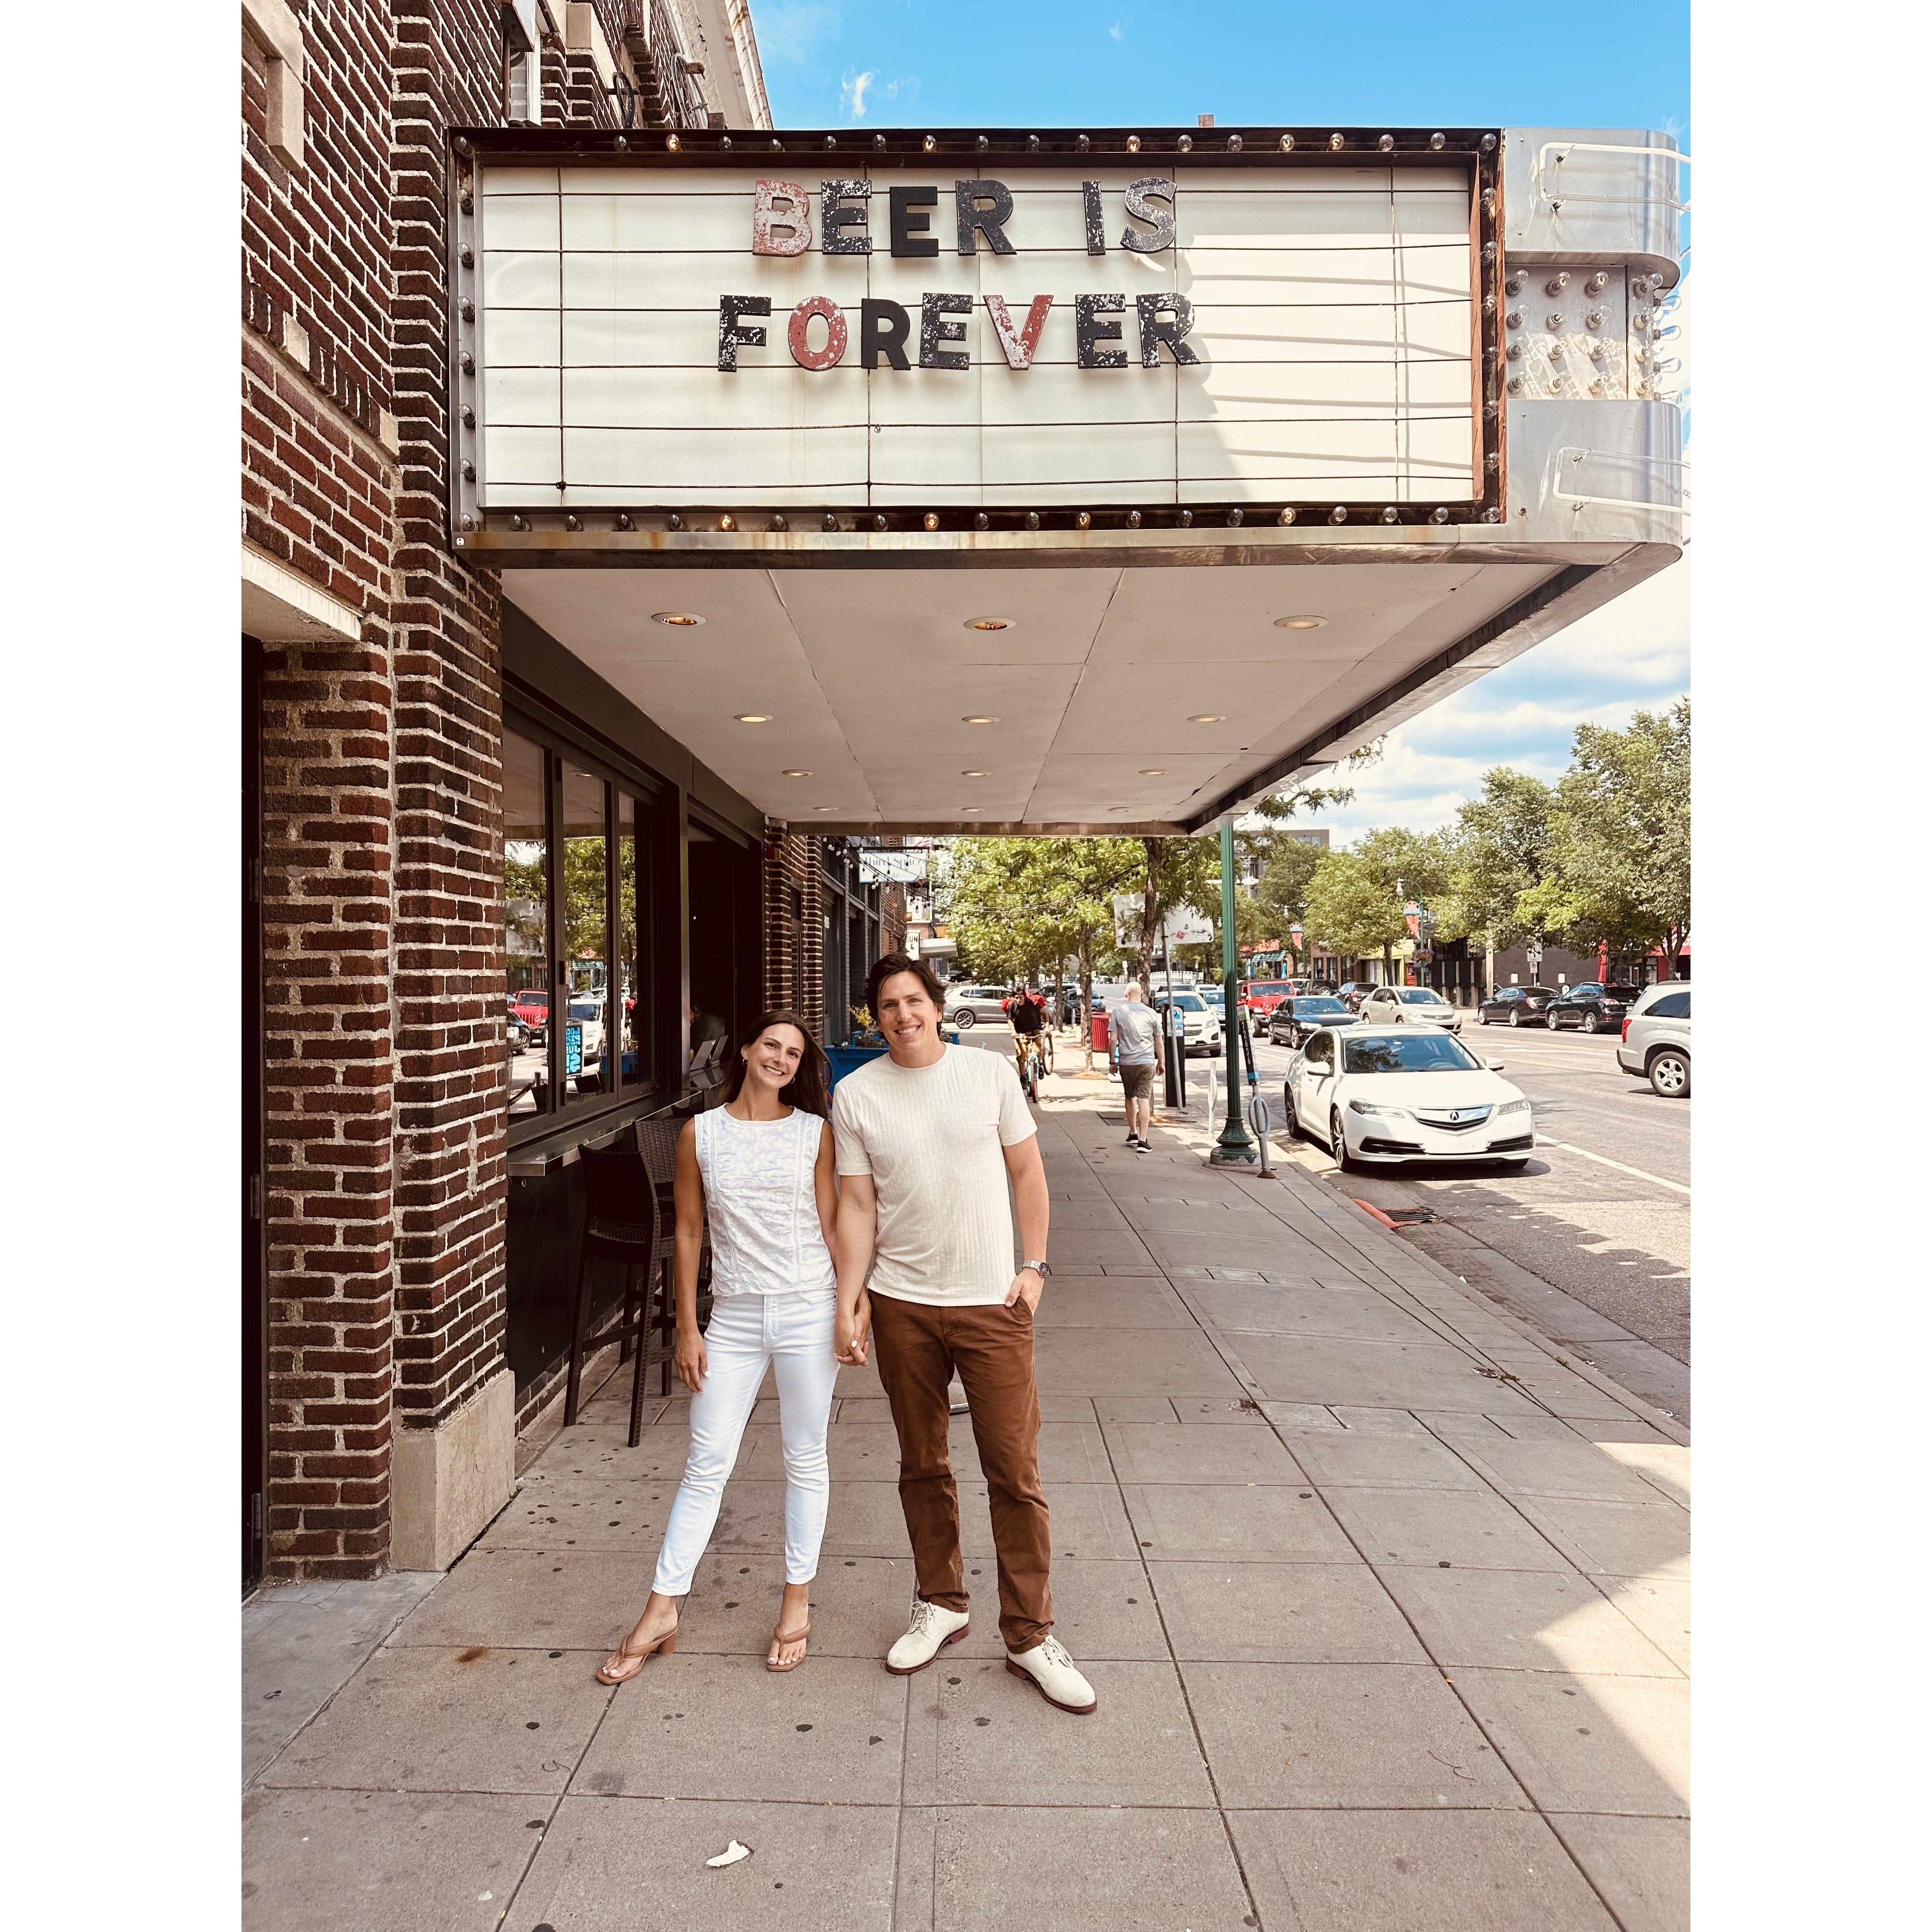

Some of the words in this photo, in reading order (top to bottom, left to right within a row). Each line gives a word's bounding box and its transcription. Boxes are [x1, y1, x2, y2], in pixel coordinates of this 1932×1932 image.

[752, 179, 1017, 258] BEER
[1082, 177, 1176, 256] IS
[718, 293, 1201, 372] FOREVER
[863, 856, 890, 866] Third
